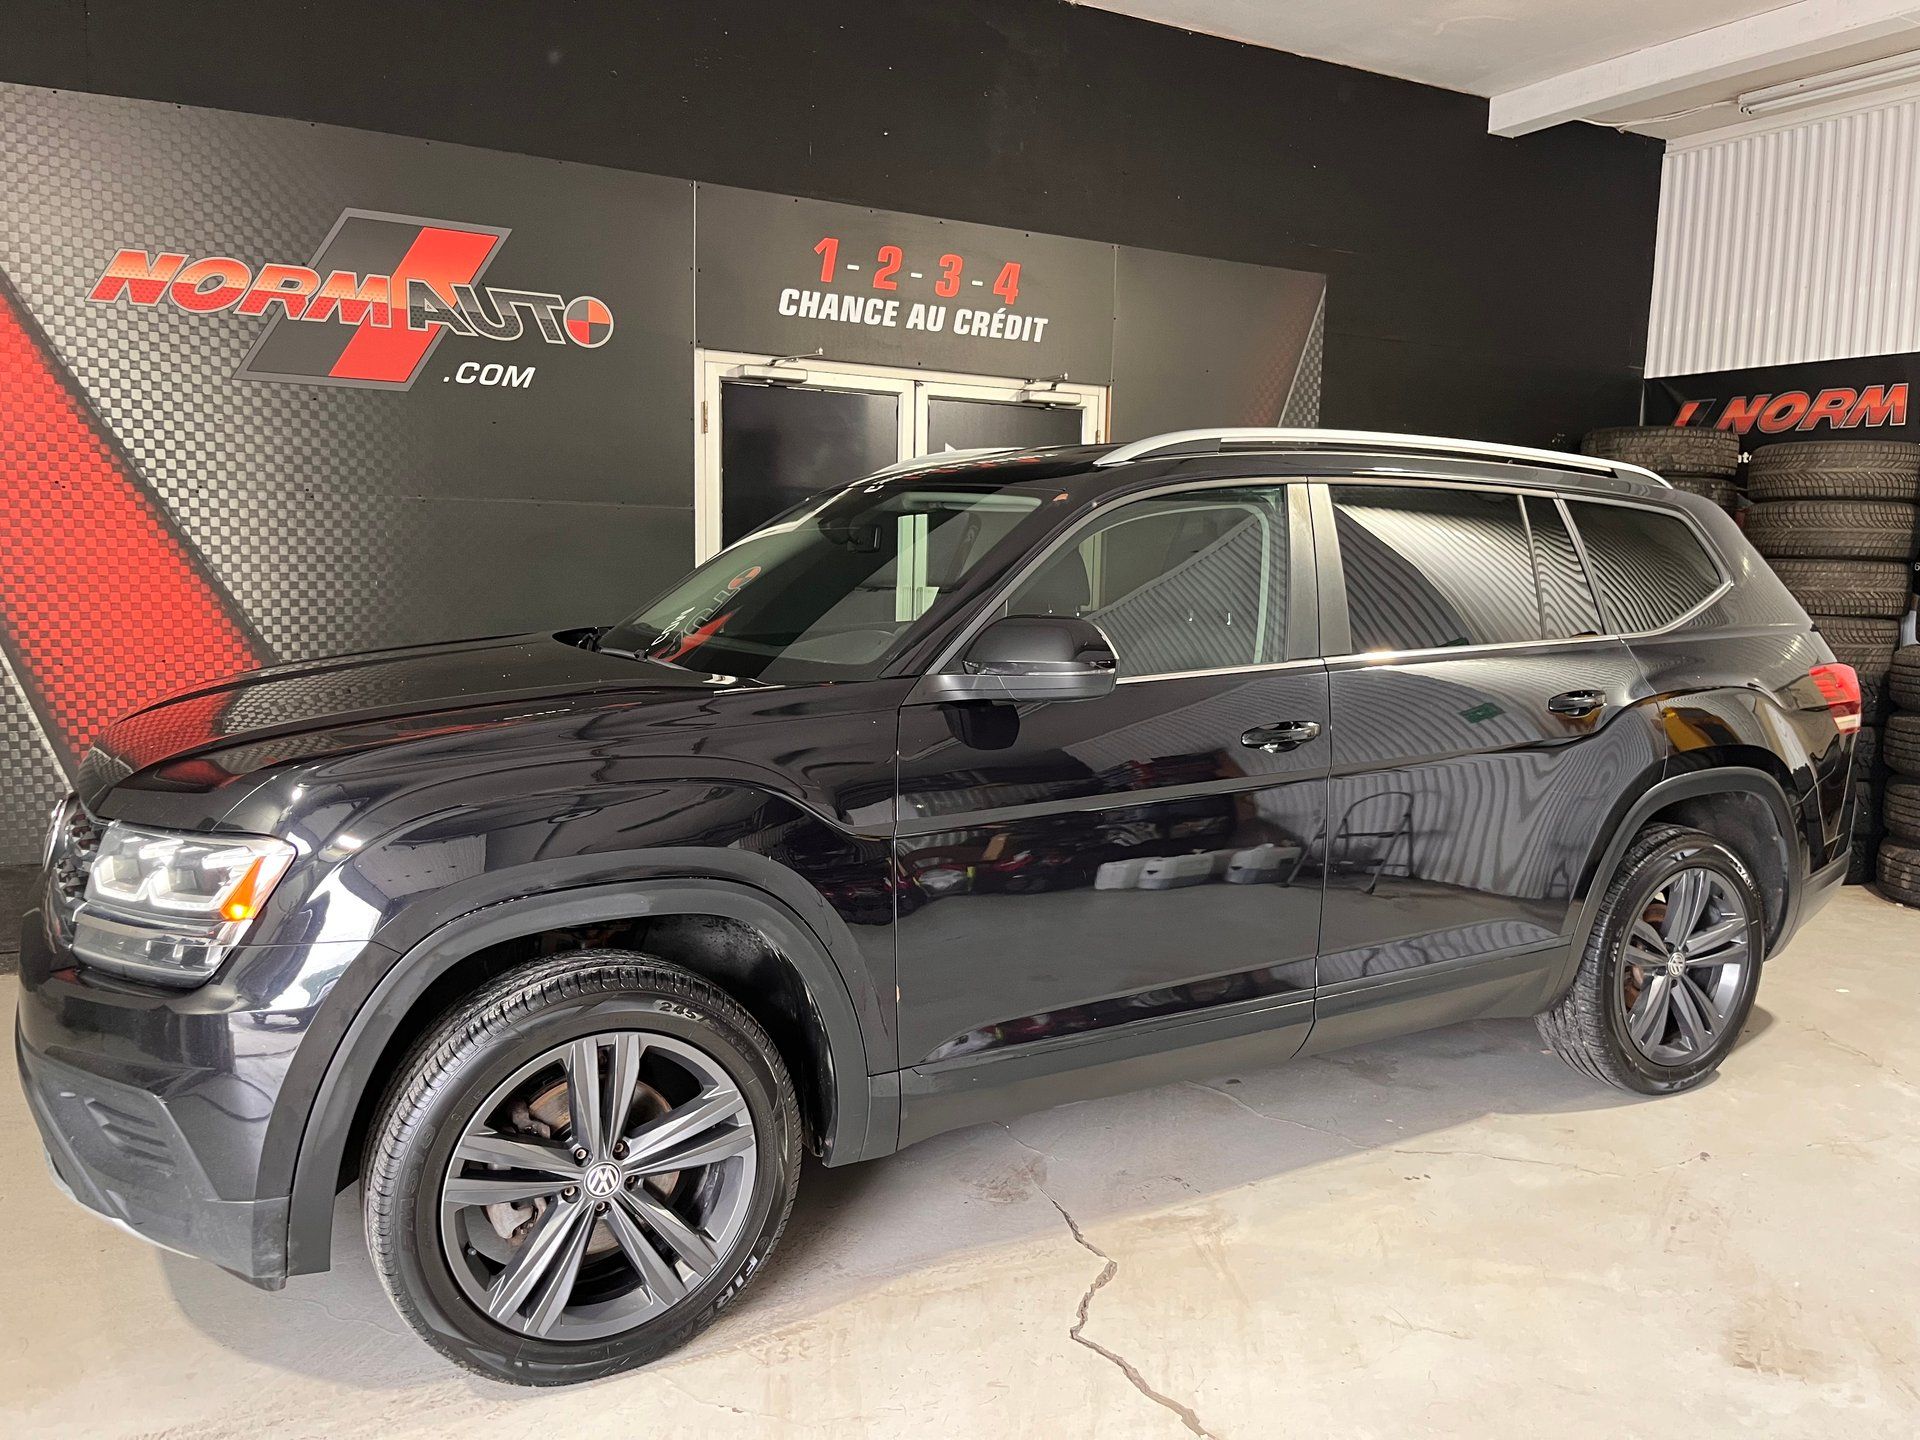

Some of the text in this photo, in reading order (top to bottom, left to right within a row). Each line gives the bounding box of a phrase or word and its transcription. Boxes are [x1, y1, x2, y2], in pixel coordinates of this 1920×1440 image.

[778, 288, 1050, 343] CHANCE AU CRÉDIT
[443, 361, 537, 389] .COM
[1713, 382, 1910, 435] NORM
